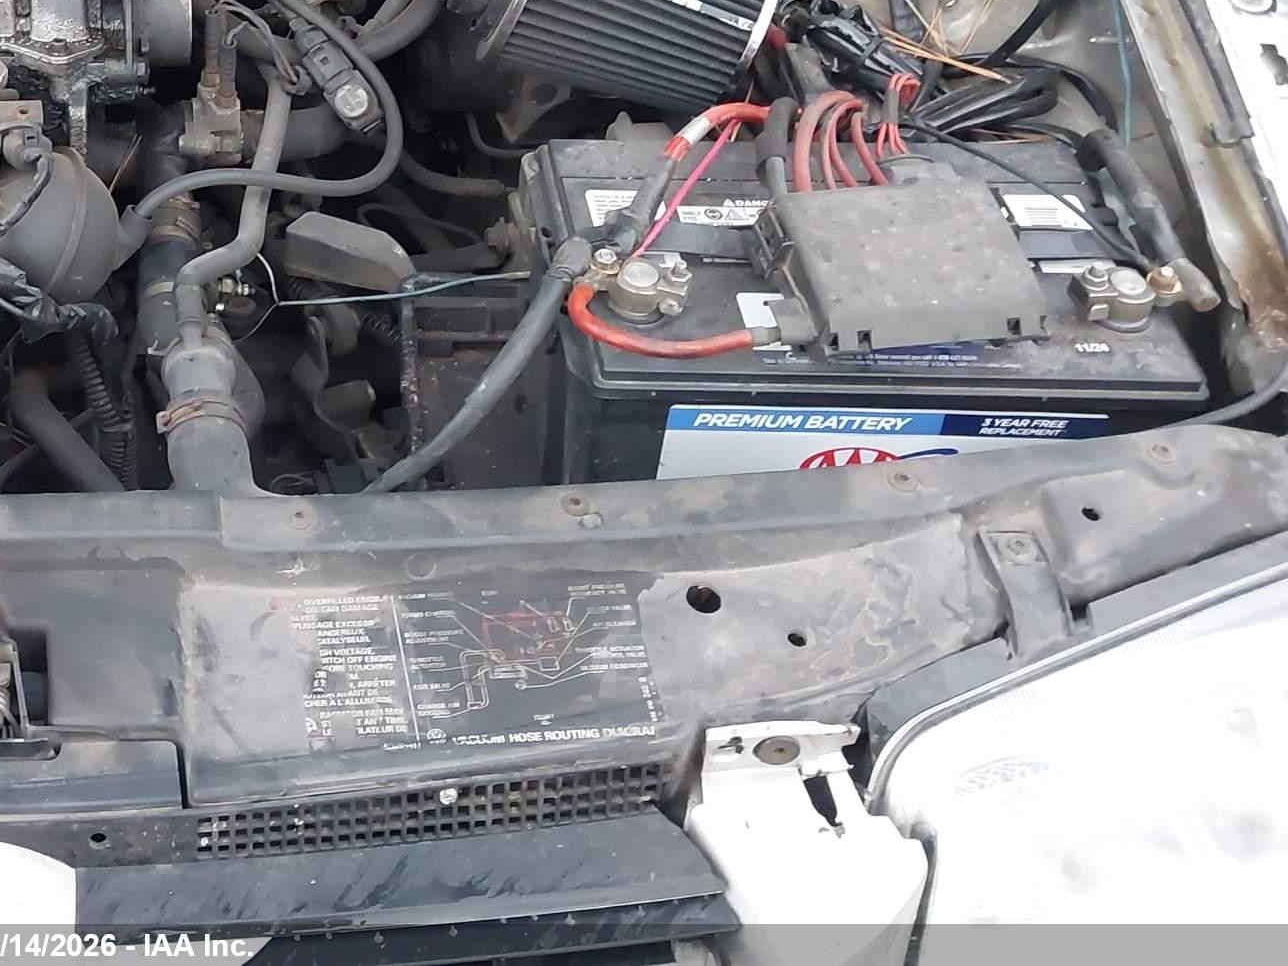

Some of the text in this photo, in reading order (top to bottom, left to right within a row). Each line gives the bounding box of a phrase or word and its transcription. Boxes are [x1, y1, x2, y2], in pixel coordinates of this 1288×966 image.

[693, 413, 913, 431] PREMIUM BATTERY
[981, 417, 1070, 429] 3 YEAR FREE
[978, 427, 1064, 437] REPLACEMENT
[509, 731, 543, 743] HOSE
[544, 728, 600, 742] ROUTING
